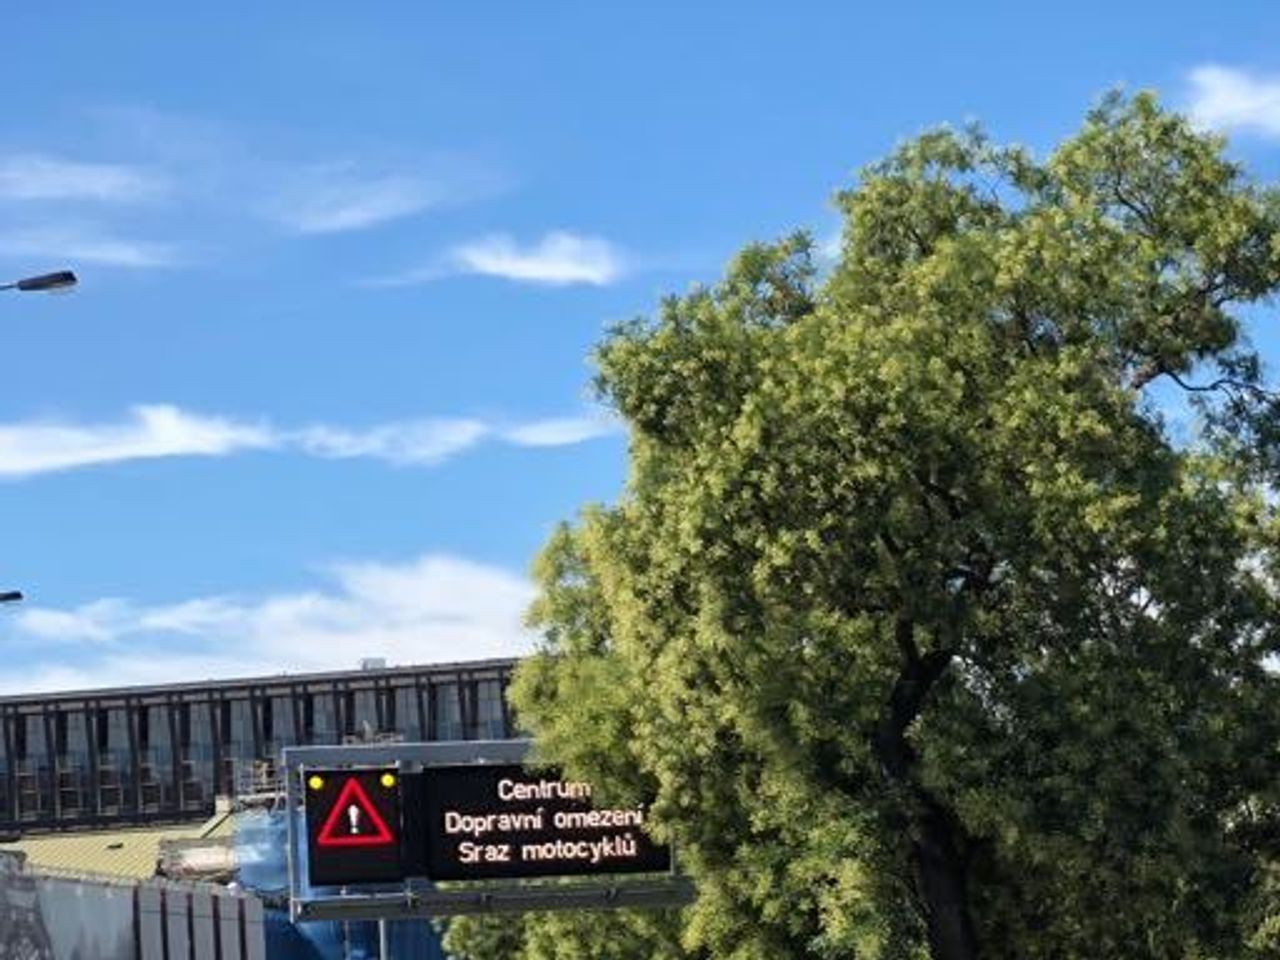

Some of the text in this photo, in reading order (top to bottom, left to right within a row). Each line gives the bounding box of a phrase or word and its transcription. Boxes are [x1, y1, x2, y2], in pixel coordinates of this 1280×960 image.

[498, 779, 591, 800] Centrum
[445, 803, 644, 837] Dopravní omezení
[458, 833, 636, 864] Sraz motocyklů
